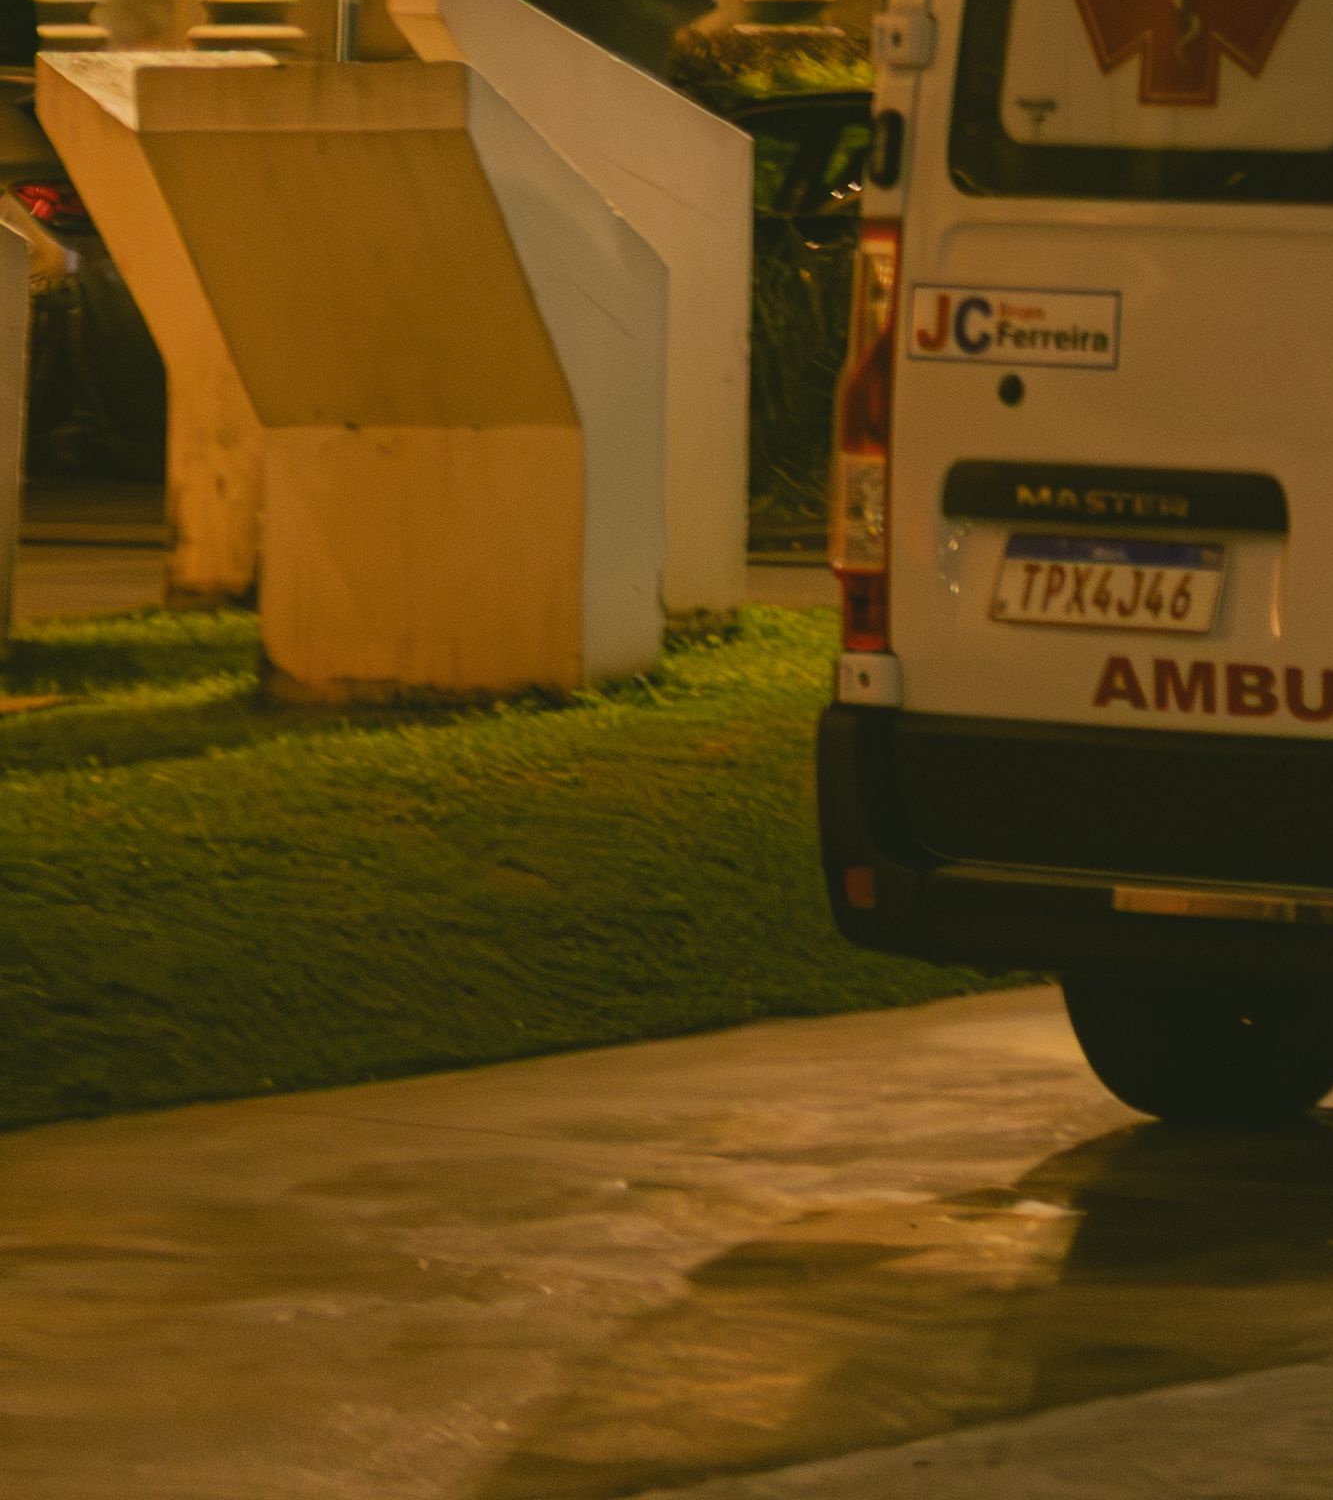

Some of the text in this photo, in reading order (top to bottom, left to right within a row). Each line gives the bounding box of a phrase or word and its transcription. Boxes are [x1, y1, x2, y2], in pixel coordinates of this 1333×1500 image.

[916, 294, 1110, 356] JC Ferreira
[1015, 484, 1190, 517] MASTER
[1021, 563, 1193, 622] TPX4J46
